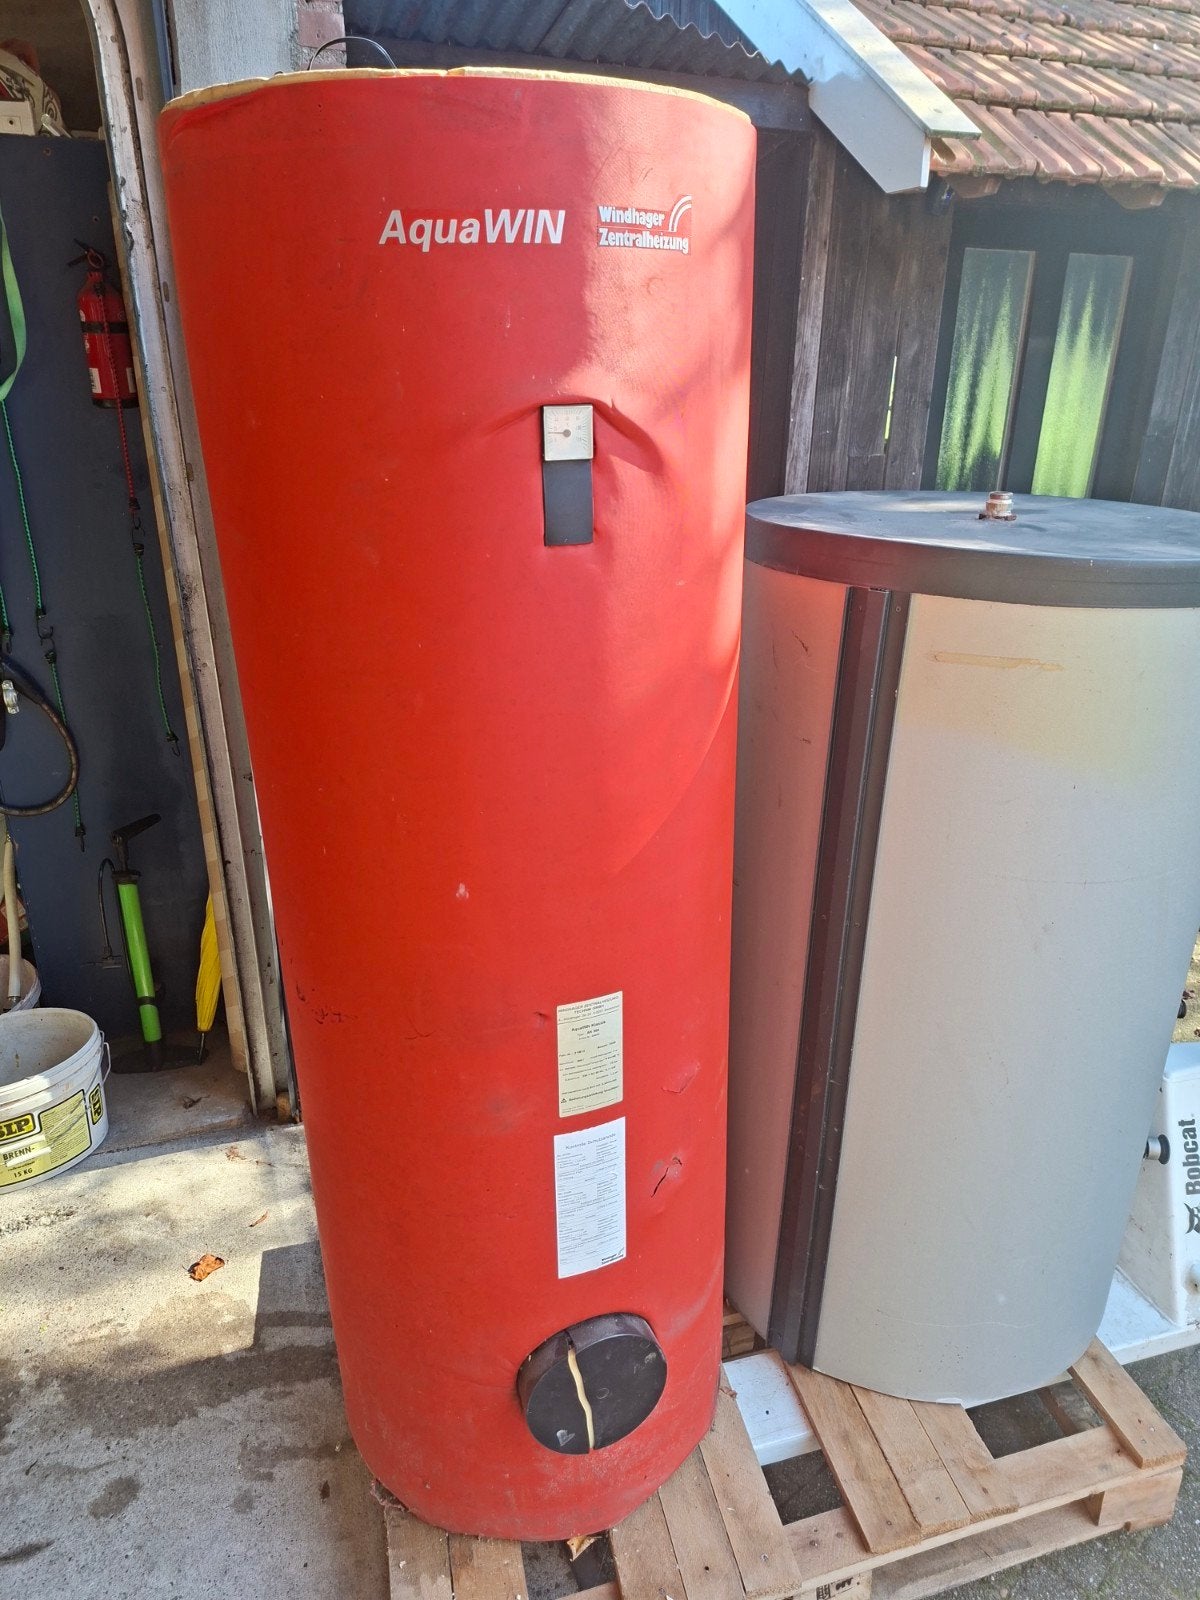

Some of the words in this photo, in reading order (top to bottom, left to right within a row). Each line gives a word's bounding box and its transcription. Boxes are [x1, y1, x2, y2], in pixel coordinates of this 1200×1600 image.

[378, 208, 566, 253] AquaWIN
[598, 205, 665, 228] Windhager
[598, 227, 690, 255] Zentralheizung
[1178, 1118, 1200, 1195] Bobcat
[14, 1170, 22, 1178] 15
[23, 1167, 33, 1176] KG
